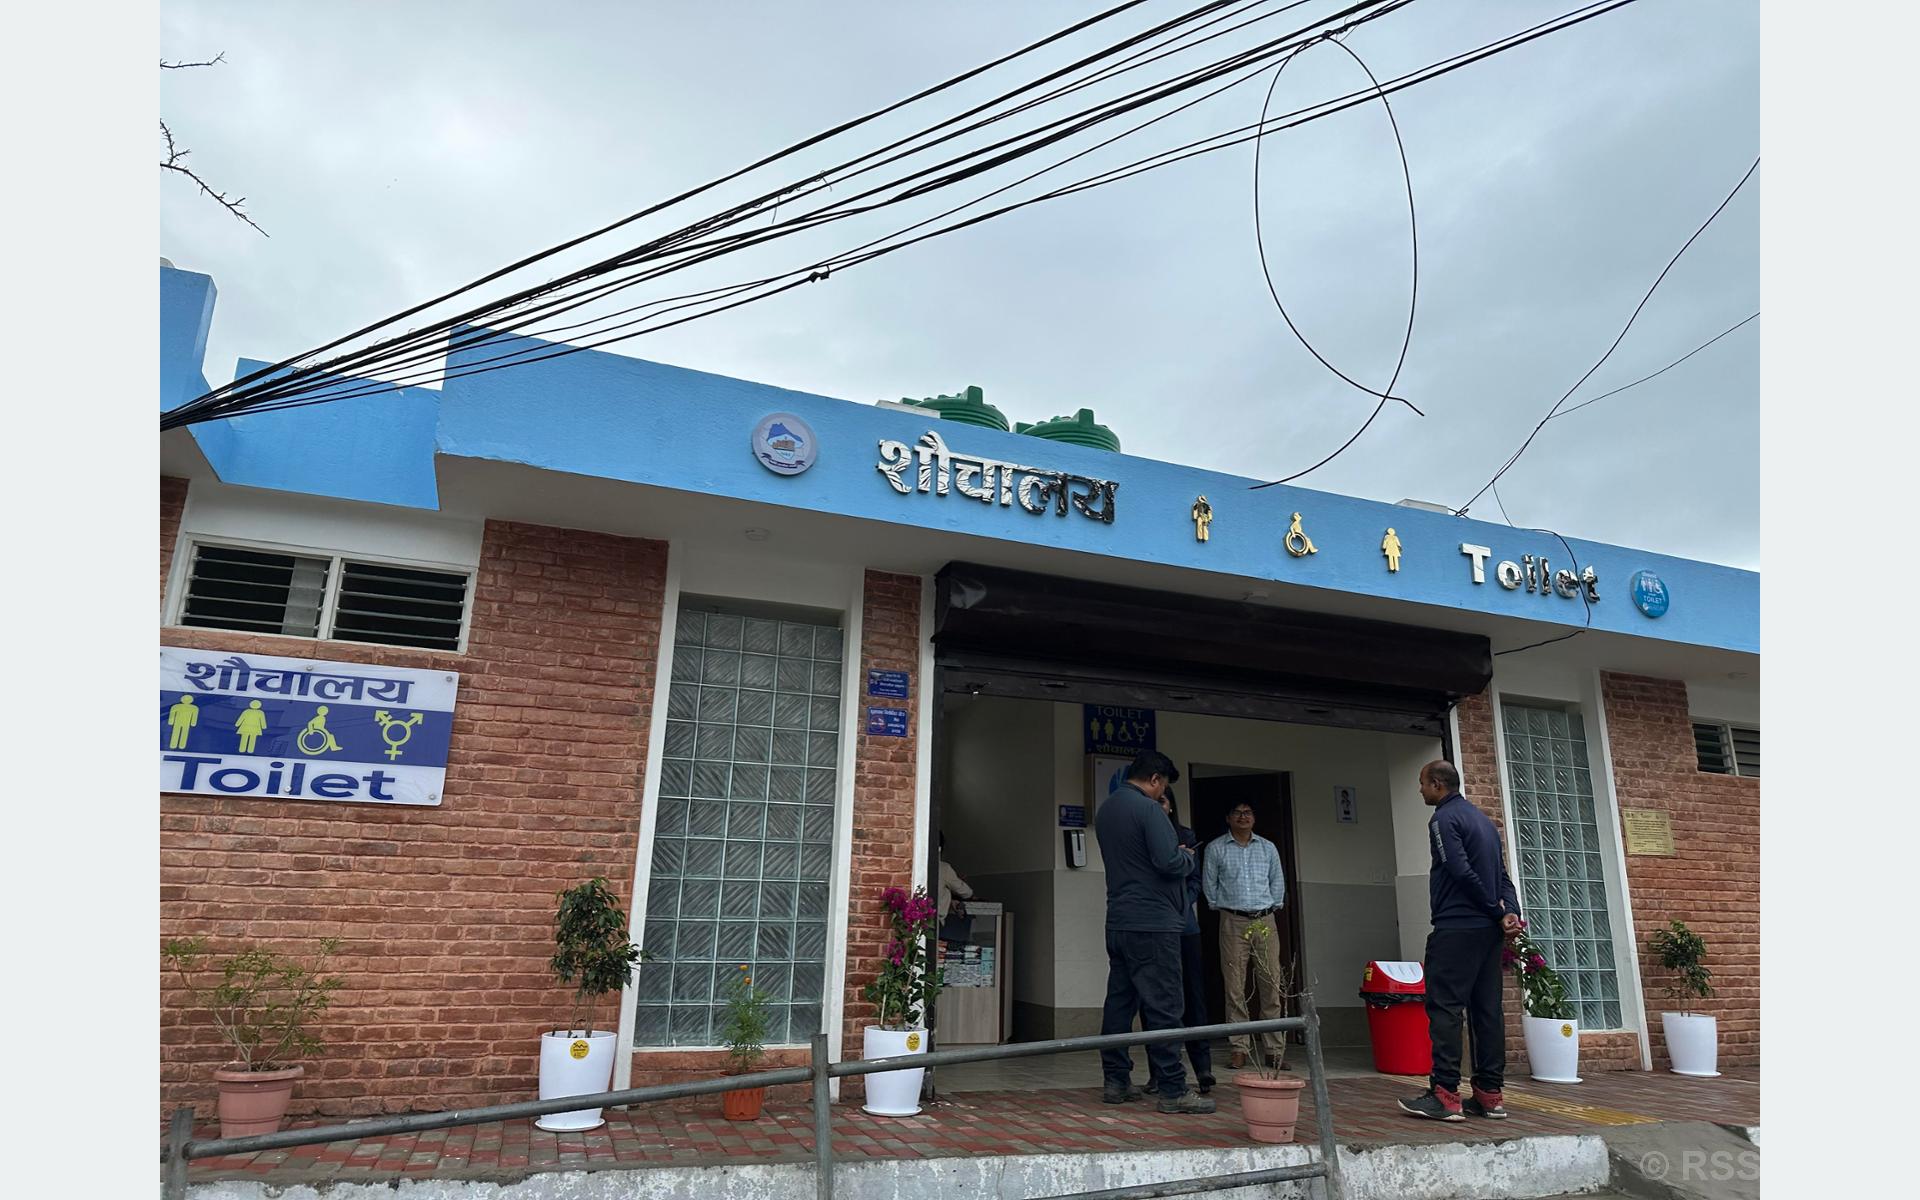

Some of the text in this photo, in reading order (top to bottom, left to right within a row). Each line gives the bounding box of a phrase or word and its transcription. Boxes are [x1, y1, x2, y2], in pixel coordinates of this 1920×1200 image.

[876, 429, 1120, 524] शौचालय
[1459, 543, 1600, 603] Toilet
[183, 656, 415, 704] शौचालय
[1096, 705, 1144, 720] TOILET
[163, 755, 396, 800] Toilet
